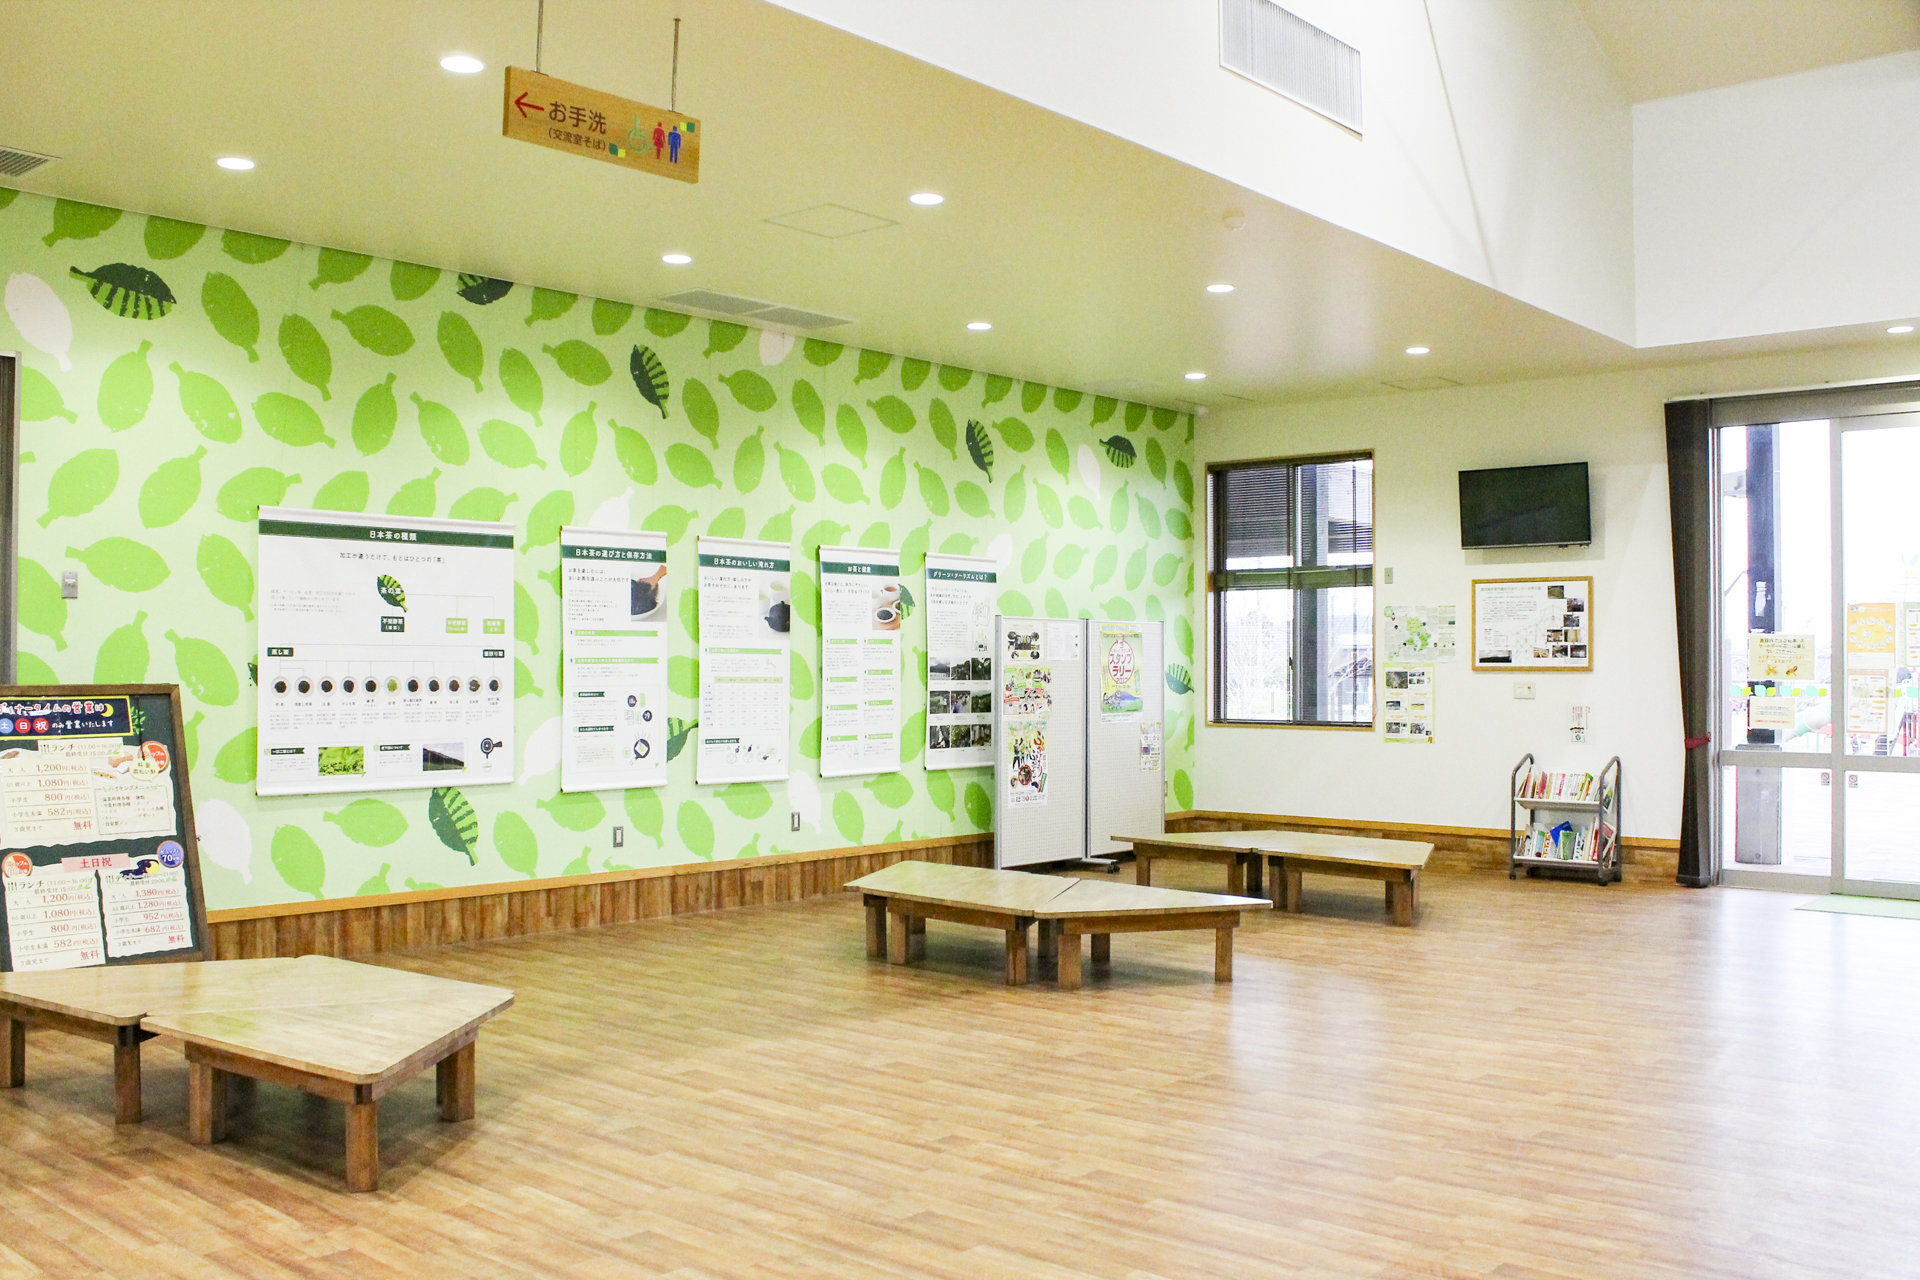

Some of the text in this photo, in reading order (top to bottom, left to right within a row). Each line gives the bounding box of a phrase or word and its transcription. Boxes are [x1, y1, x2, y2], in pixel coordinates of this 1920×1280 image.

[549, 101, 606, 135] お手洗
[548, 127, 606, 152] (交流室そば)
[369, 530, 418, 541] 日本茶の種類
[575, 548, 653, 560] 日本茶の選び方と保存方法
[713, 558, 775, 569] 日本茶のおいしい淹れ方
[847, 565, 872, 573] お茶と健康
[933, 570, 988, 581] グリーン・ツーリズムとは?
[1109, 653, 1133, 666] スタンプ
[1112, 665, 1132, 677] ラリー
[51, 743, 75, 752] ランチ
[73, 821, 92, 830] 無料
[80, 857, 112, 868] 土日祝
[19, 880, 45, 890] ランチ
[168, 935, 184, 944] 無料
[80, 950, 99, 960] 無料
